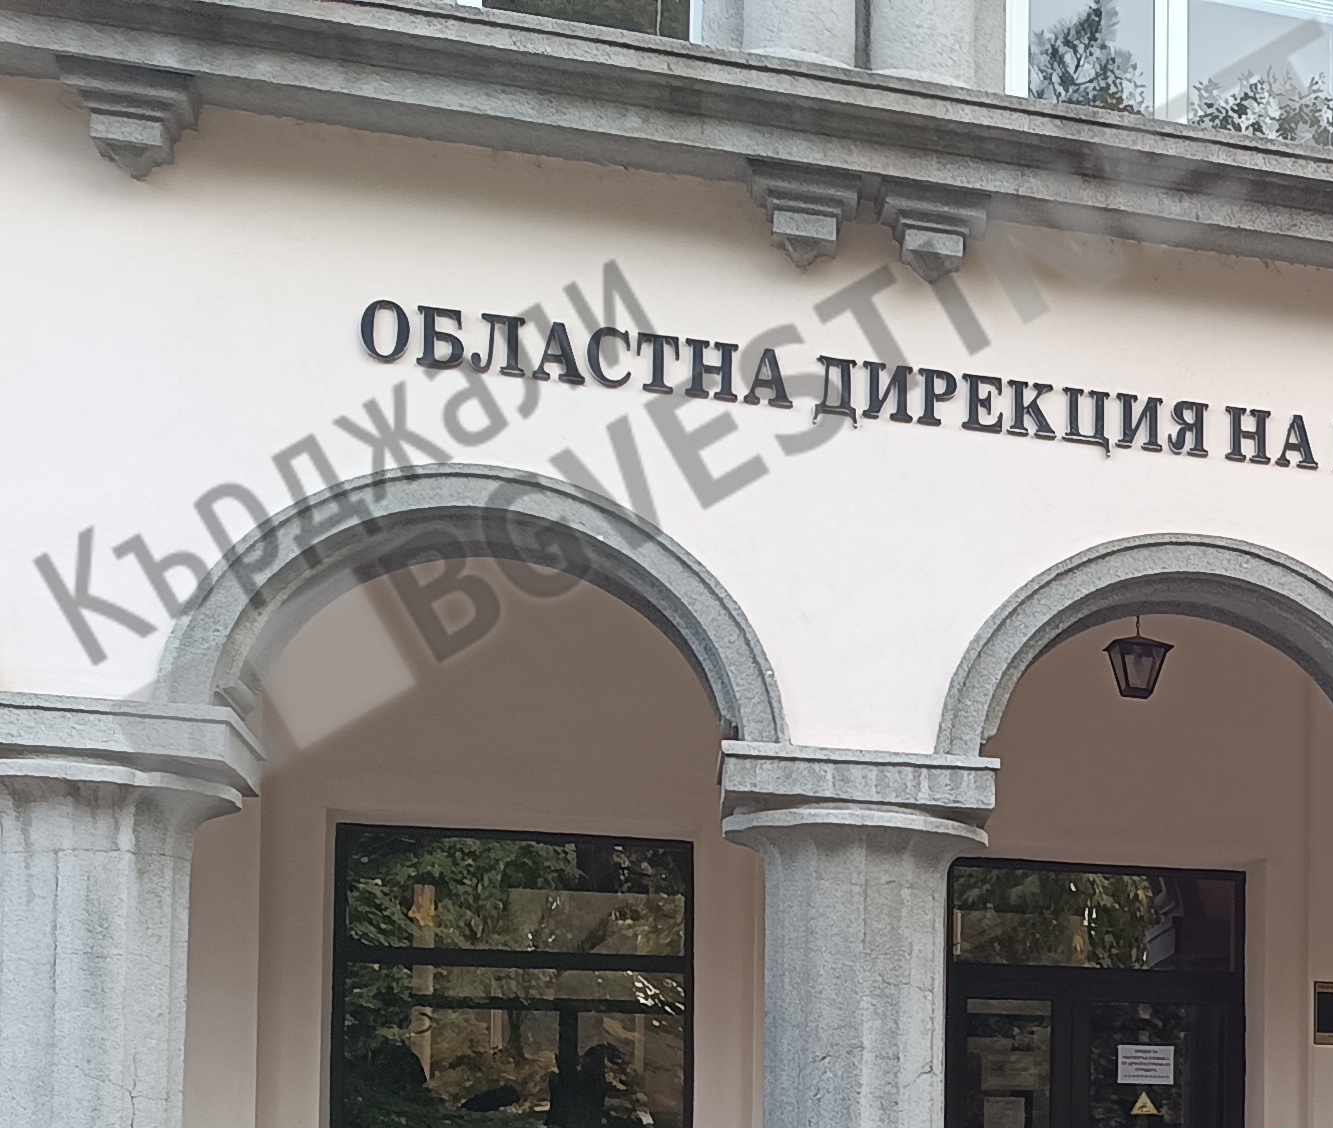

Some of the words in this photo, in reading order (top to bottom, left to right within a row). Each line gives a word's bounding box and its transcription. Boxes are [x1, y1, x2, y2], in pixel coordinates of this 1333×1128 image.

[359, 299, 795, 410] ОБЛАСТНА
[812, 354, 1209, 458] ДИРЕКЦИЯ
[1225, 405, 1319, 473] НА
